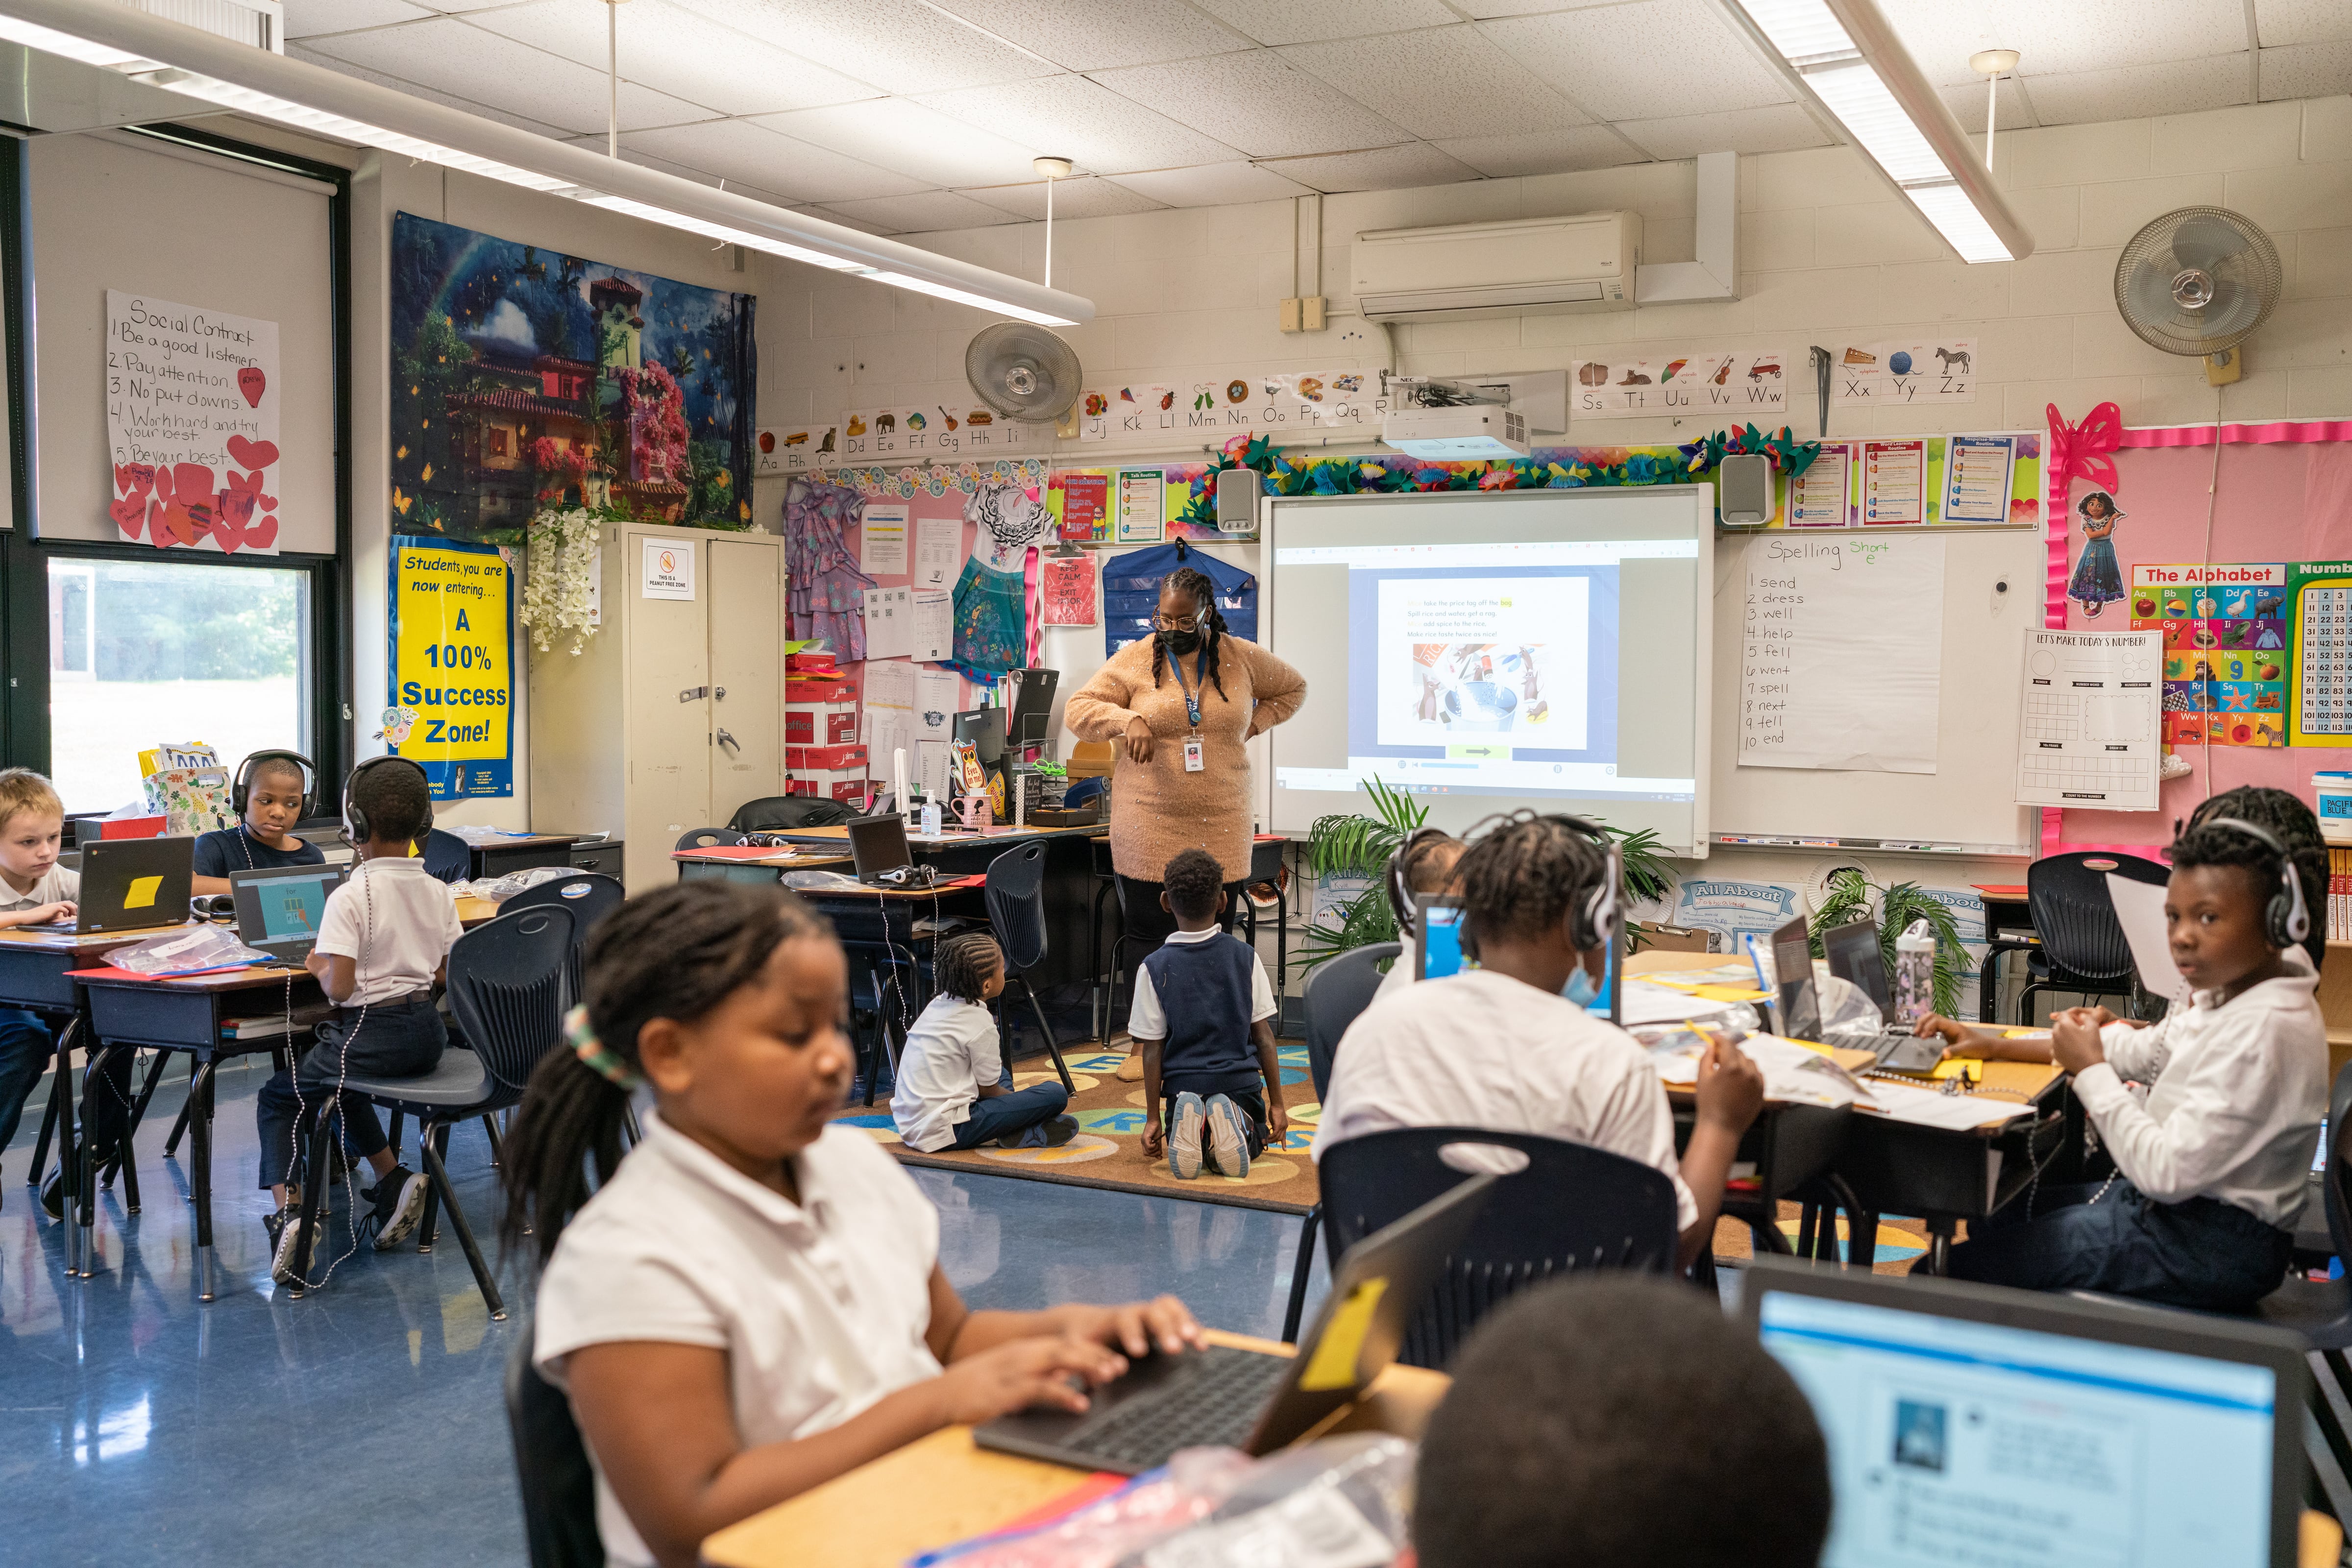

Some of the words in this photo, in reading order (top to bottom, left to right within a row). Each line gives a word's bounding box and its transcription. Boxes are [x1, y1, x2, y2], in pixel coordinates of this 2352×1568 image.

[131, 300, 188, 333] Social
[194, 315, 254, 346] Contract
[121, 322, 144, 343] Be
[148, 338, 158, 346] a
[162, 340, 198, 360] good
[206, 342, 257, 367] listener
[109, 352, 122, 368] 2.
[123, 352, 156, 385] Pay
[159, 365, 233, 389] attention.
[110, 377, 125, 393] 3.
[130, 378, 149, 398] No
[156, 389, 183, 406] put
[187, 391, 243, 410] downs.
[111, 401, 123, 424] 4.
[130, 405, 171, 427] Work
[174, 414, 208, 429] hard
[213, 419, 237, 431] and
[238, 419, 258, 442] try
[124, 428, 159, 444] your
[163, 429, 200, 441] best.
[117, 447, 128, 464] 5.
[130, 444, 150, 462] Be
[153, 450, 183, 469] your
[190, 447, 230, 465] best.
[1768, 541, 1841, 570] Spelling
[1850, 541, 1889, 553] Short
[1866, 554, 1875, 564] e
[464, 564, 479, 577] you
[484, 566, 502, 576] are
[2146, 569, 2178, 582] The
[2185, 567, 2272, 585] Alphabet
[1751, 573, 1756, 587] 1.
[1760, 577, 1796, 589] send
[412, 581, 440, 592] now
[446, 582, 495, 599] entering...
[2133, 589, 2146, 598] Aa
[1747, 594, 1759, 604] 2.
[1763, 593, 1804, 604] dress
[455, 609, 470, 632] A
[1748, 609, 1760, 620] 3.
[1764, 608, 1792, 619] well
[1747, 626, 1759, 639] 4.
[1764, 625, 1793, 641] help
[2037, 635, 2054, 644] LET'S
[2056, 635, 2076, 646] MAKE
[2079, 636, 2109, 647] TODAY'S
[2112, 637, 2146, 647] NUMBER!
[424, 644, 491, 670] 100%
[1748, 646, 1759, 658] 5.
[1764, 644, 1790, 658] fell
[1747, 665, 1758, 677] 6.
[1761, 665, 1790, 675] went
[402, 682, 507, 706] Success
[1748, 683, 1756, 694] 7.
[1760, 684, 1788, 695] spell
[1747, 700, 1756, 713] 8.
[1759, 700, 1787, 710] next
[1746, 717, 1755, 730] 9.
[1758, 715, 1782, 728] tell
[2258, 714, 2270, 722] Zz
[425, 719, 490, 743] Zone!
[1745, 736, 1760, 751] 10.
[1764, 730, 1784, 744] end
[967, 767, 978, 776] Eyes
[990, 786, 1001, 812] quietly.
[1000, 789, 1004, 797] up
[1695, 884, 1720, 897] All
[1723, 885, 1781, 903] About
